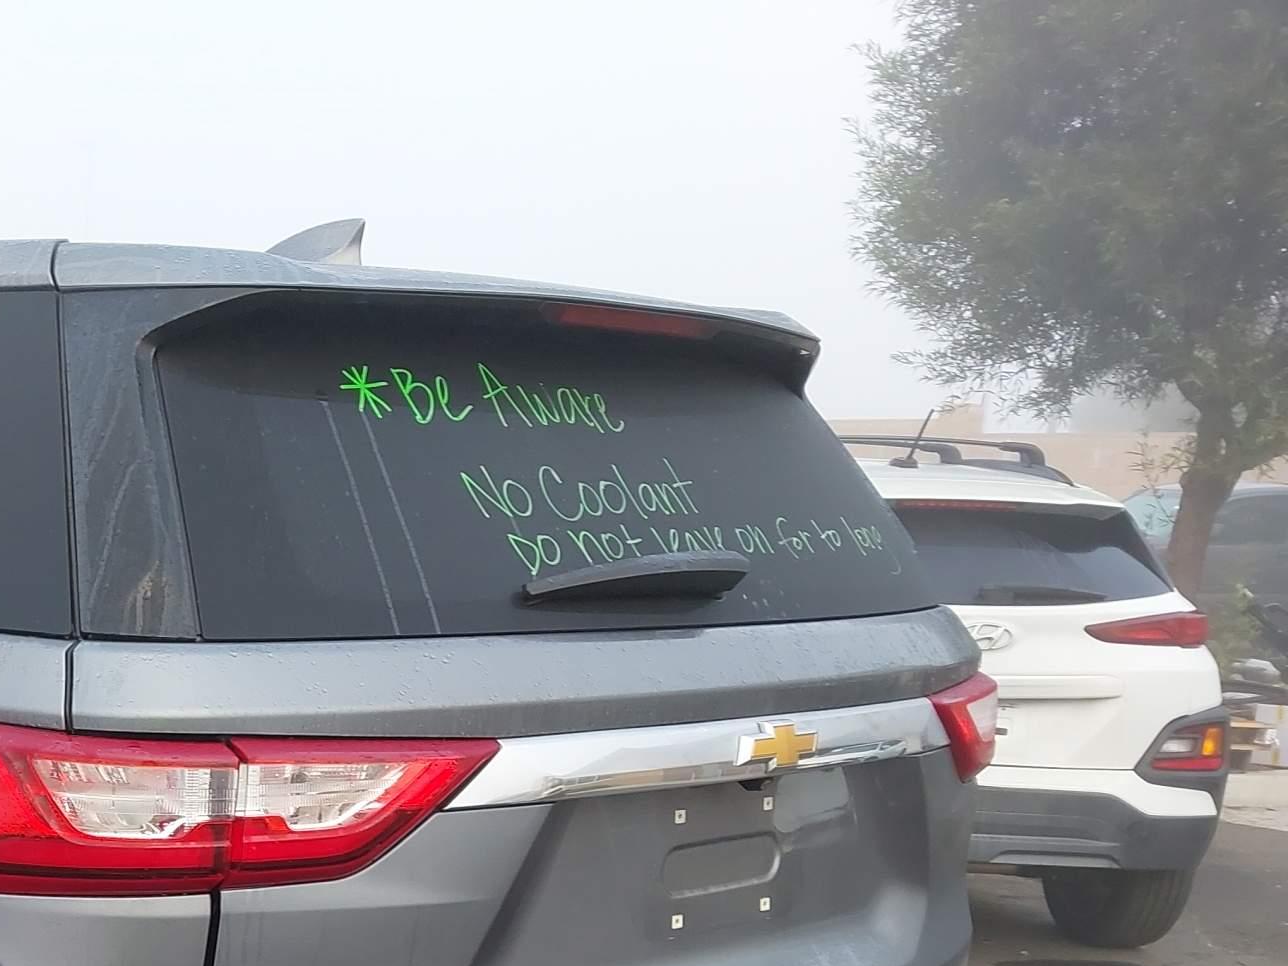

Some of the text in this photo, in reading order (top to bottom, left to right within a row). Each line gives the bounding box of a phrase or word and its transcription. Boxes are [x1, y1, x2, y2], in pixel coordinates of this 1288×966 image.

[477, 362, 624, 434] Aware
[459, 457, 699, 521] No Coolant
[507, 533, 561, 575] Do
[567, 524, 643, 566] not
[735, 522, 774, 555] on
[775, 515, 814, 560] for
[812, 519, 842, 553] to
